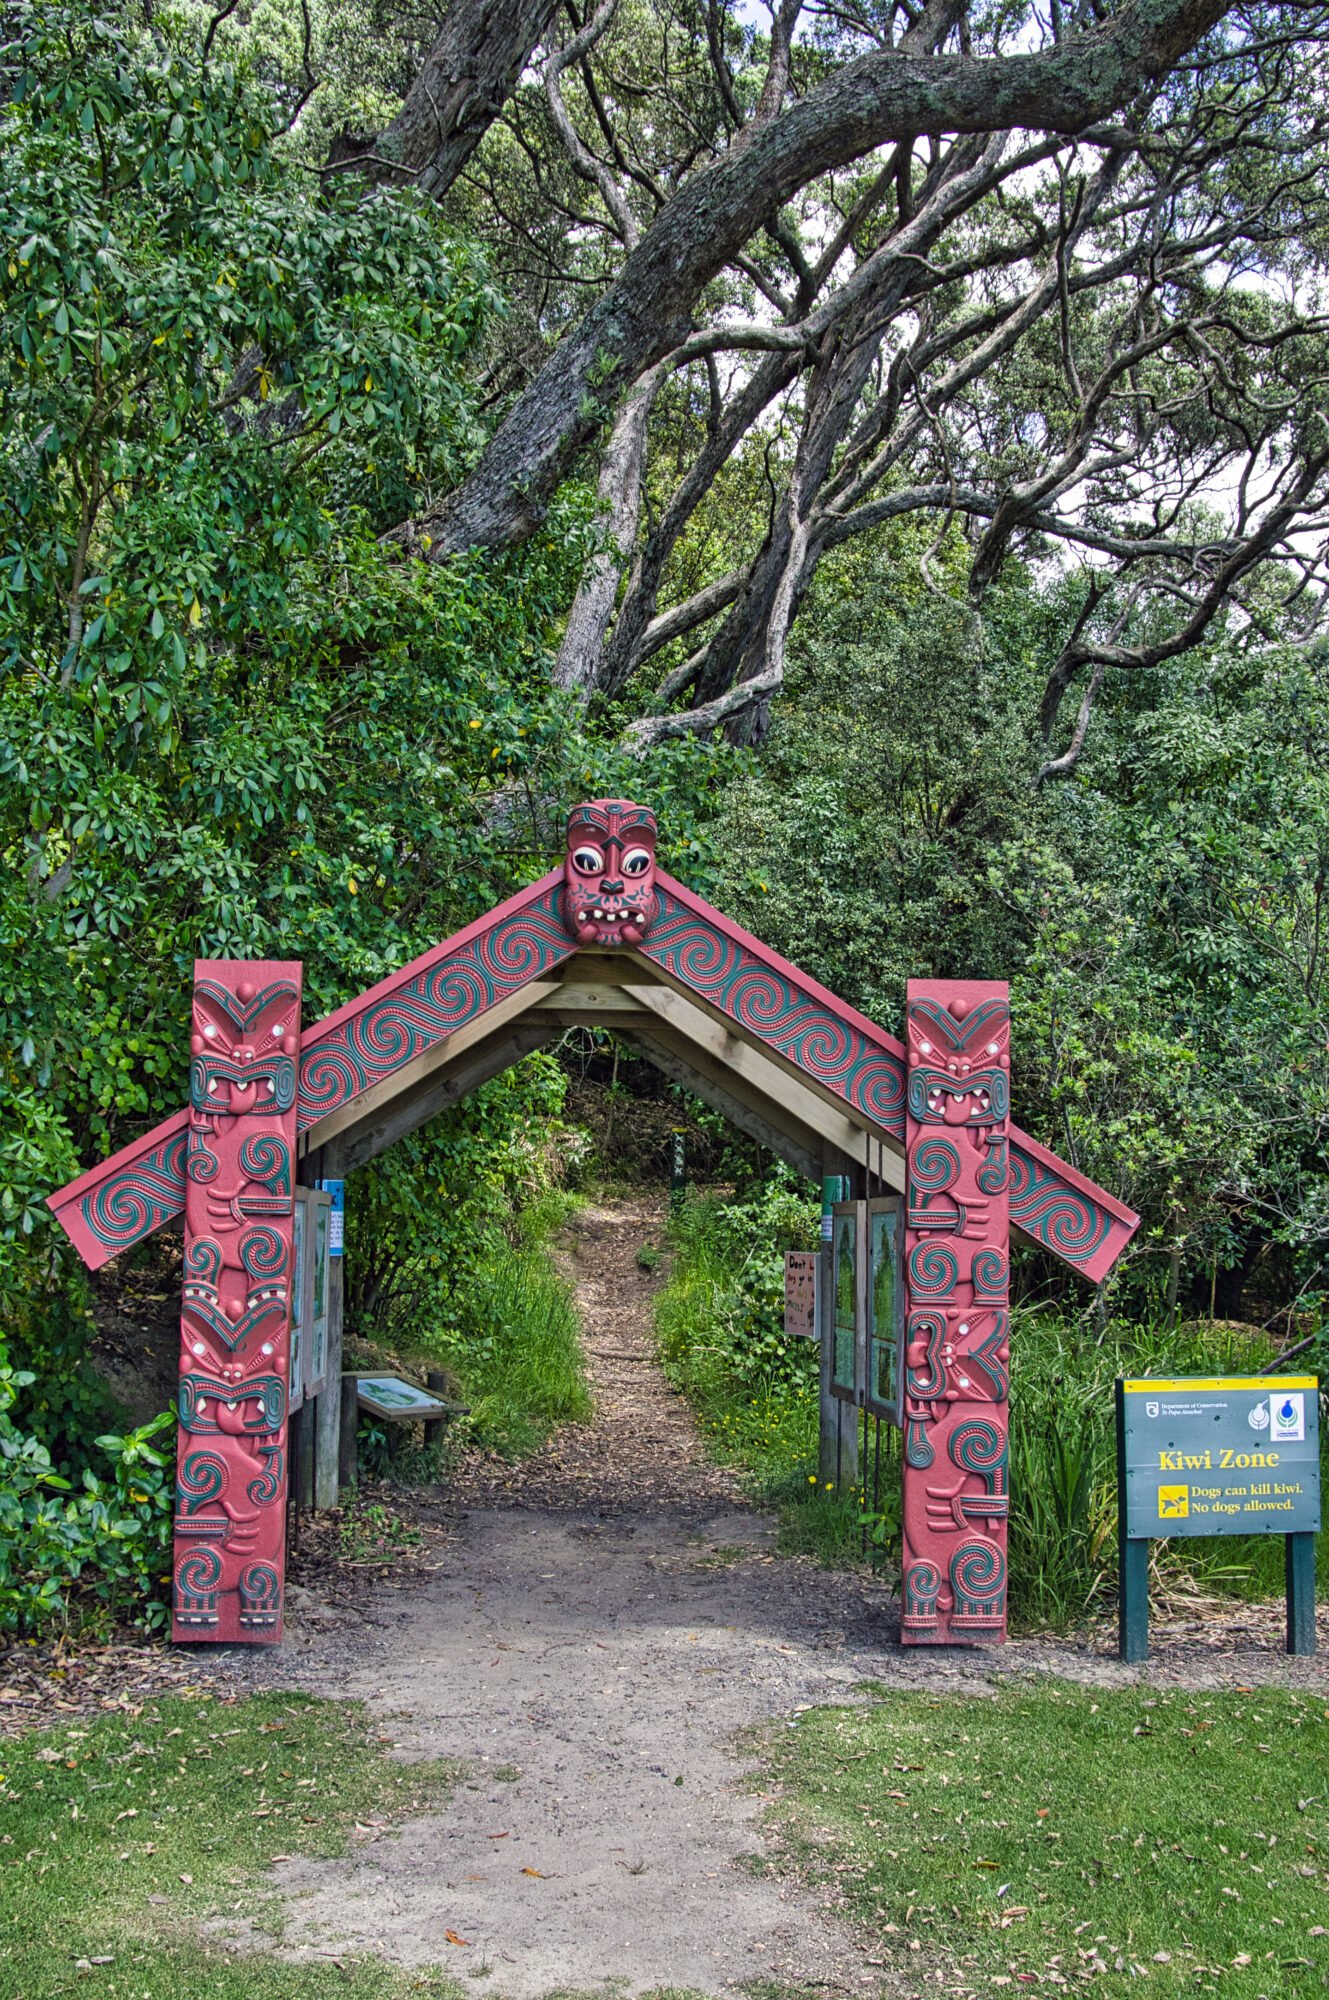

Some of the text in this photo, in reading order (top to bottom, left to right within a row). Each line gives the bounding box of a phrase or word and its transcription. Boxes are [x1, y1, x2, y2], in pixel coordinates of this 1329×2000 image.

[1158, 1449, 1280, 1471] Kiwi Zone
[1191, 1483, 1303, 1499] Dogs can kill kiwi.
[1191, 1499, 1295, 1514] No dogs allowed.
